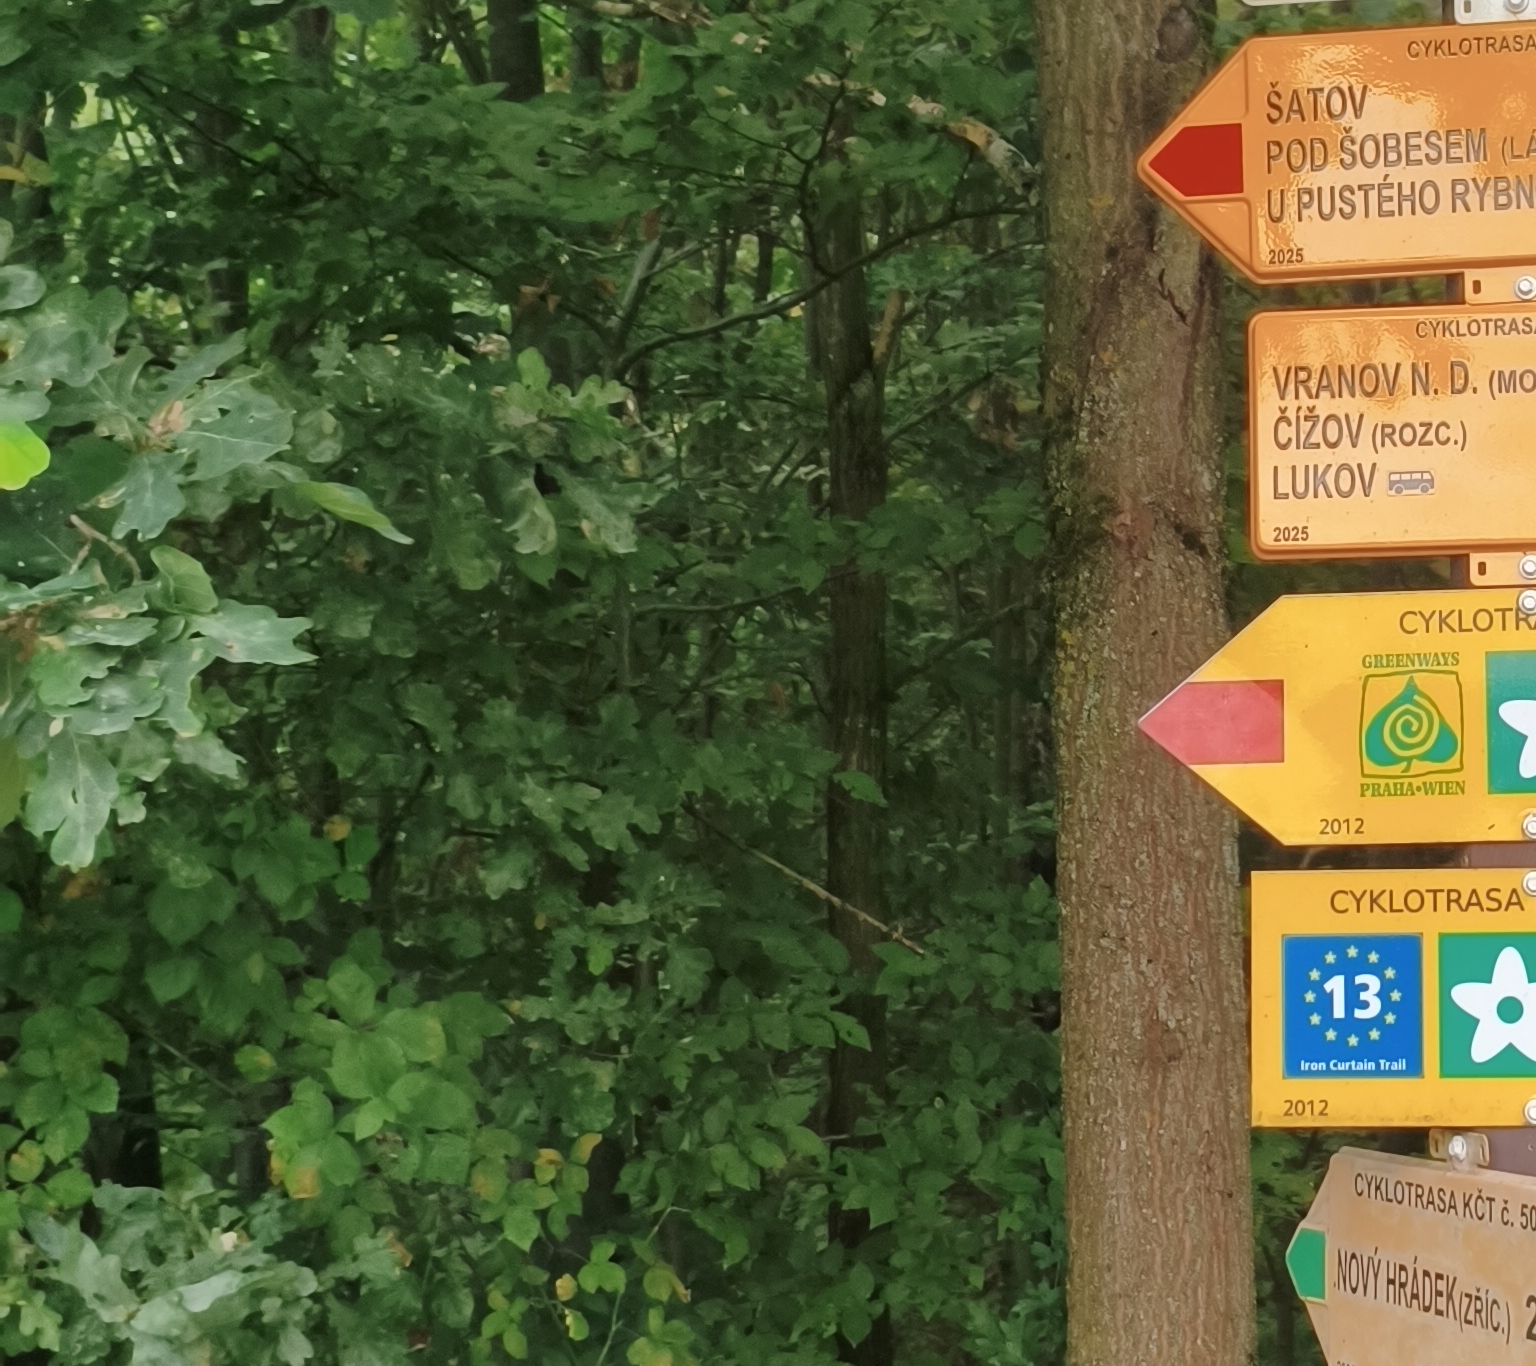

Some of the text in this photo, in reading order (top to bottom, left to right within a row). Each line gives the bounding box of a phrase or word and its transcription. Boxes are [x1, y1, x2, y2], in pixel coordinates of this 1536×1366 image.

[1266, 83, 1368, 126] ŠATOV
[1266, 138, 1328, 175] POD
[1341, 127, 1488, 172] ŠOBESEM
[1267, 189, 1286, 222] U
[1296, 174, 1439, 221] PUSTÉHO
[1269, 248, 1304, 265] 2025
[1273, 363, 1400, 400] VRANOV
[1411, 362, 1440, 396] N.
[1450, 360, 1477, 395] D.
[1273, 405, 1363, 451] ČÍŽOV
[1371, 420, 1467, 453] (ROZC.)
[1273, 462, 1377, 500] LUKOV
[1273, 526, 1309, 543] 2025
[1362, 651, 1460, 670] GREENWAYS
[1319, 818, 1364, 836] 2012
[1330, 888, 1524, 914] CYKLOTRASA
[1324, 974, 1383, 1019] 13
[1300, 1057, 1406, 1072] Iron Curtain Trail
[1283, 1099, 1329, 1117] 2012
[1354, 1173, 1458, 1215] CYKLOTRASA
[1463, 1186, 1495, 1223] KČT
[1501, 1198, 1514, 1227] č.
